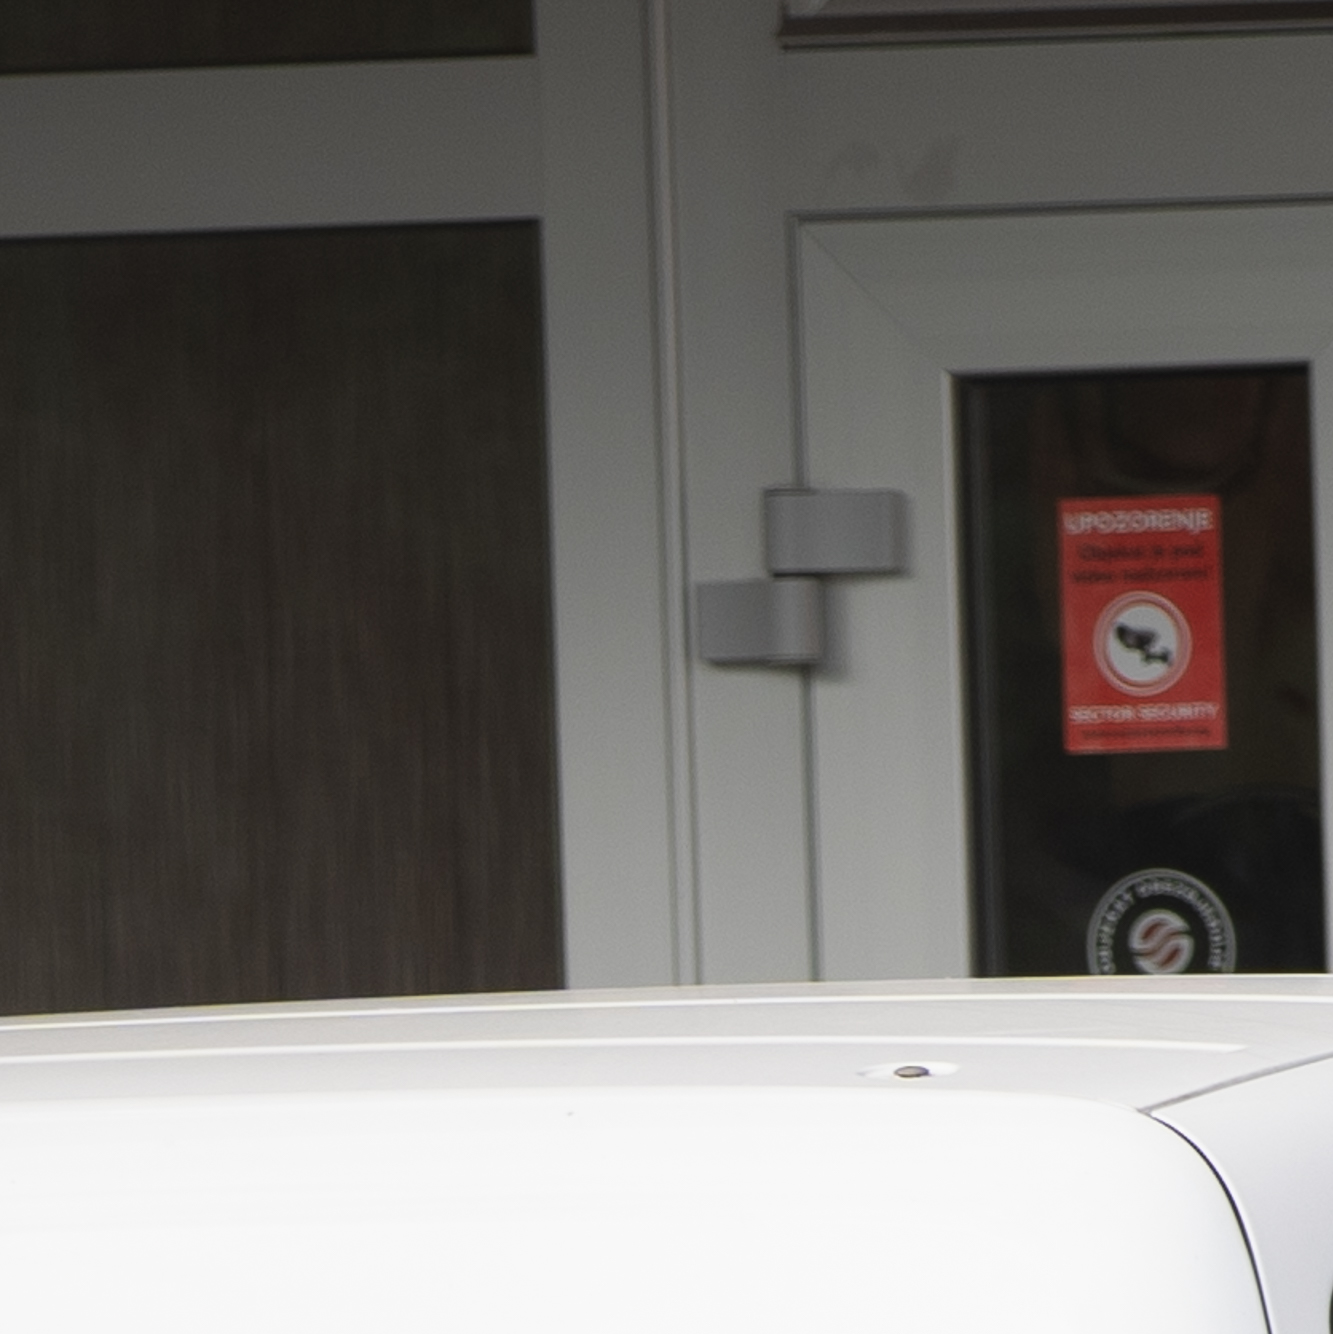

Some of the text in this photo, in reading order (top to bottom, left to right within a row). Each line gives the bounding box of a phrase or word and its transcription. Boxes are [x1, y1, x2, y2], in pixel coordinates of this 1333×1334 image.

[1064, 508, 1213, 534] UPOZORENJE
[1067, 702, 1221, 725] SECTOR SECURITY
